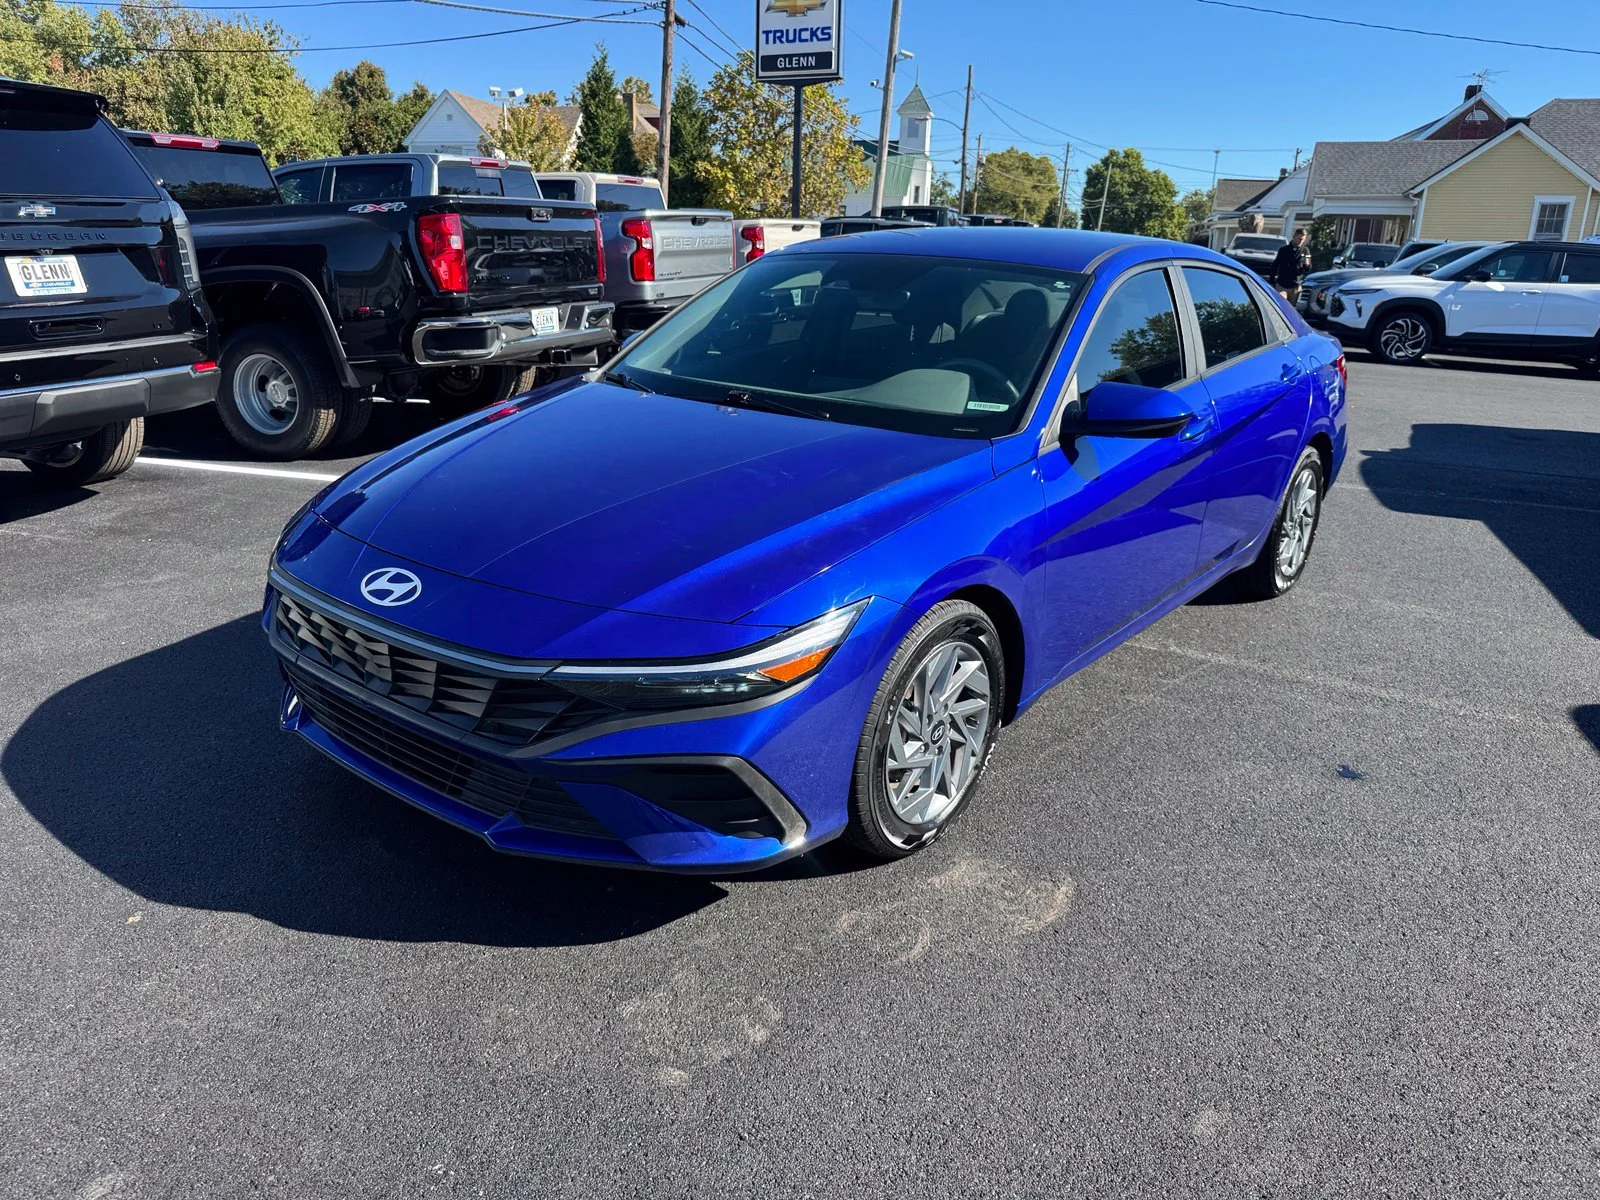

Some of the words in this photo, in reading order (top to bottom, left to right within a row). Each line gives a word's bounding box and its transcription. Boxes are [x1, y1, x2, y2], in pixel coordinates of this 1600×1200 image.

[762, 26, 832, 45] TRUCKS
[777, 56, 816, 68] GLENN
[476, 235, 591, 249] CHEVROLET
[663, 236, 732, 249] CHEVROLET
[21, 264, 71, 281] GLENN
[536, 314, 555, 327] GLENN
